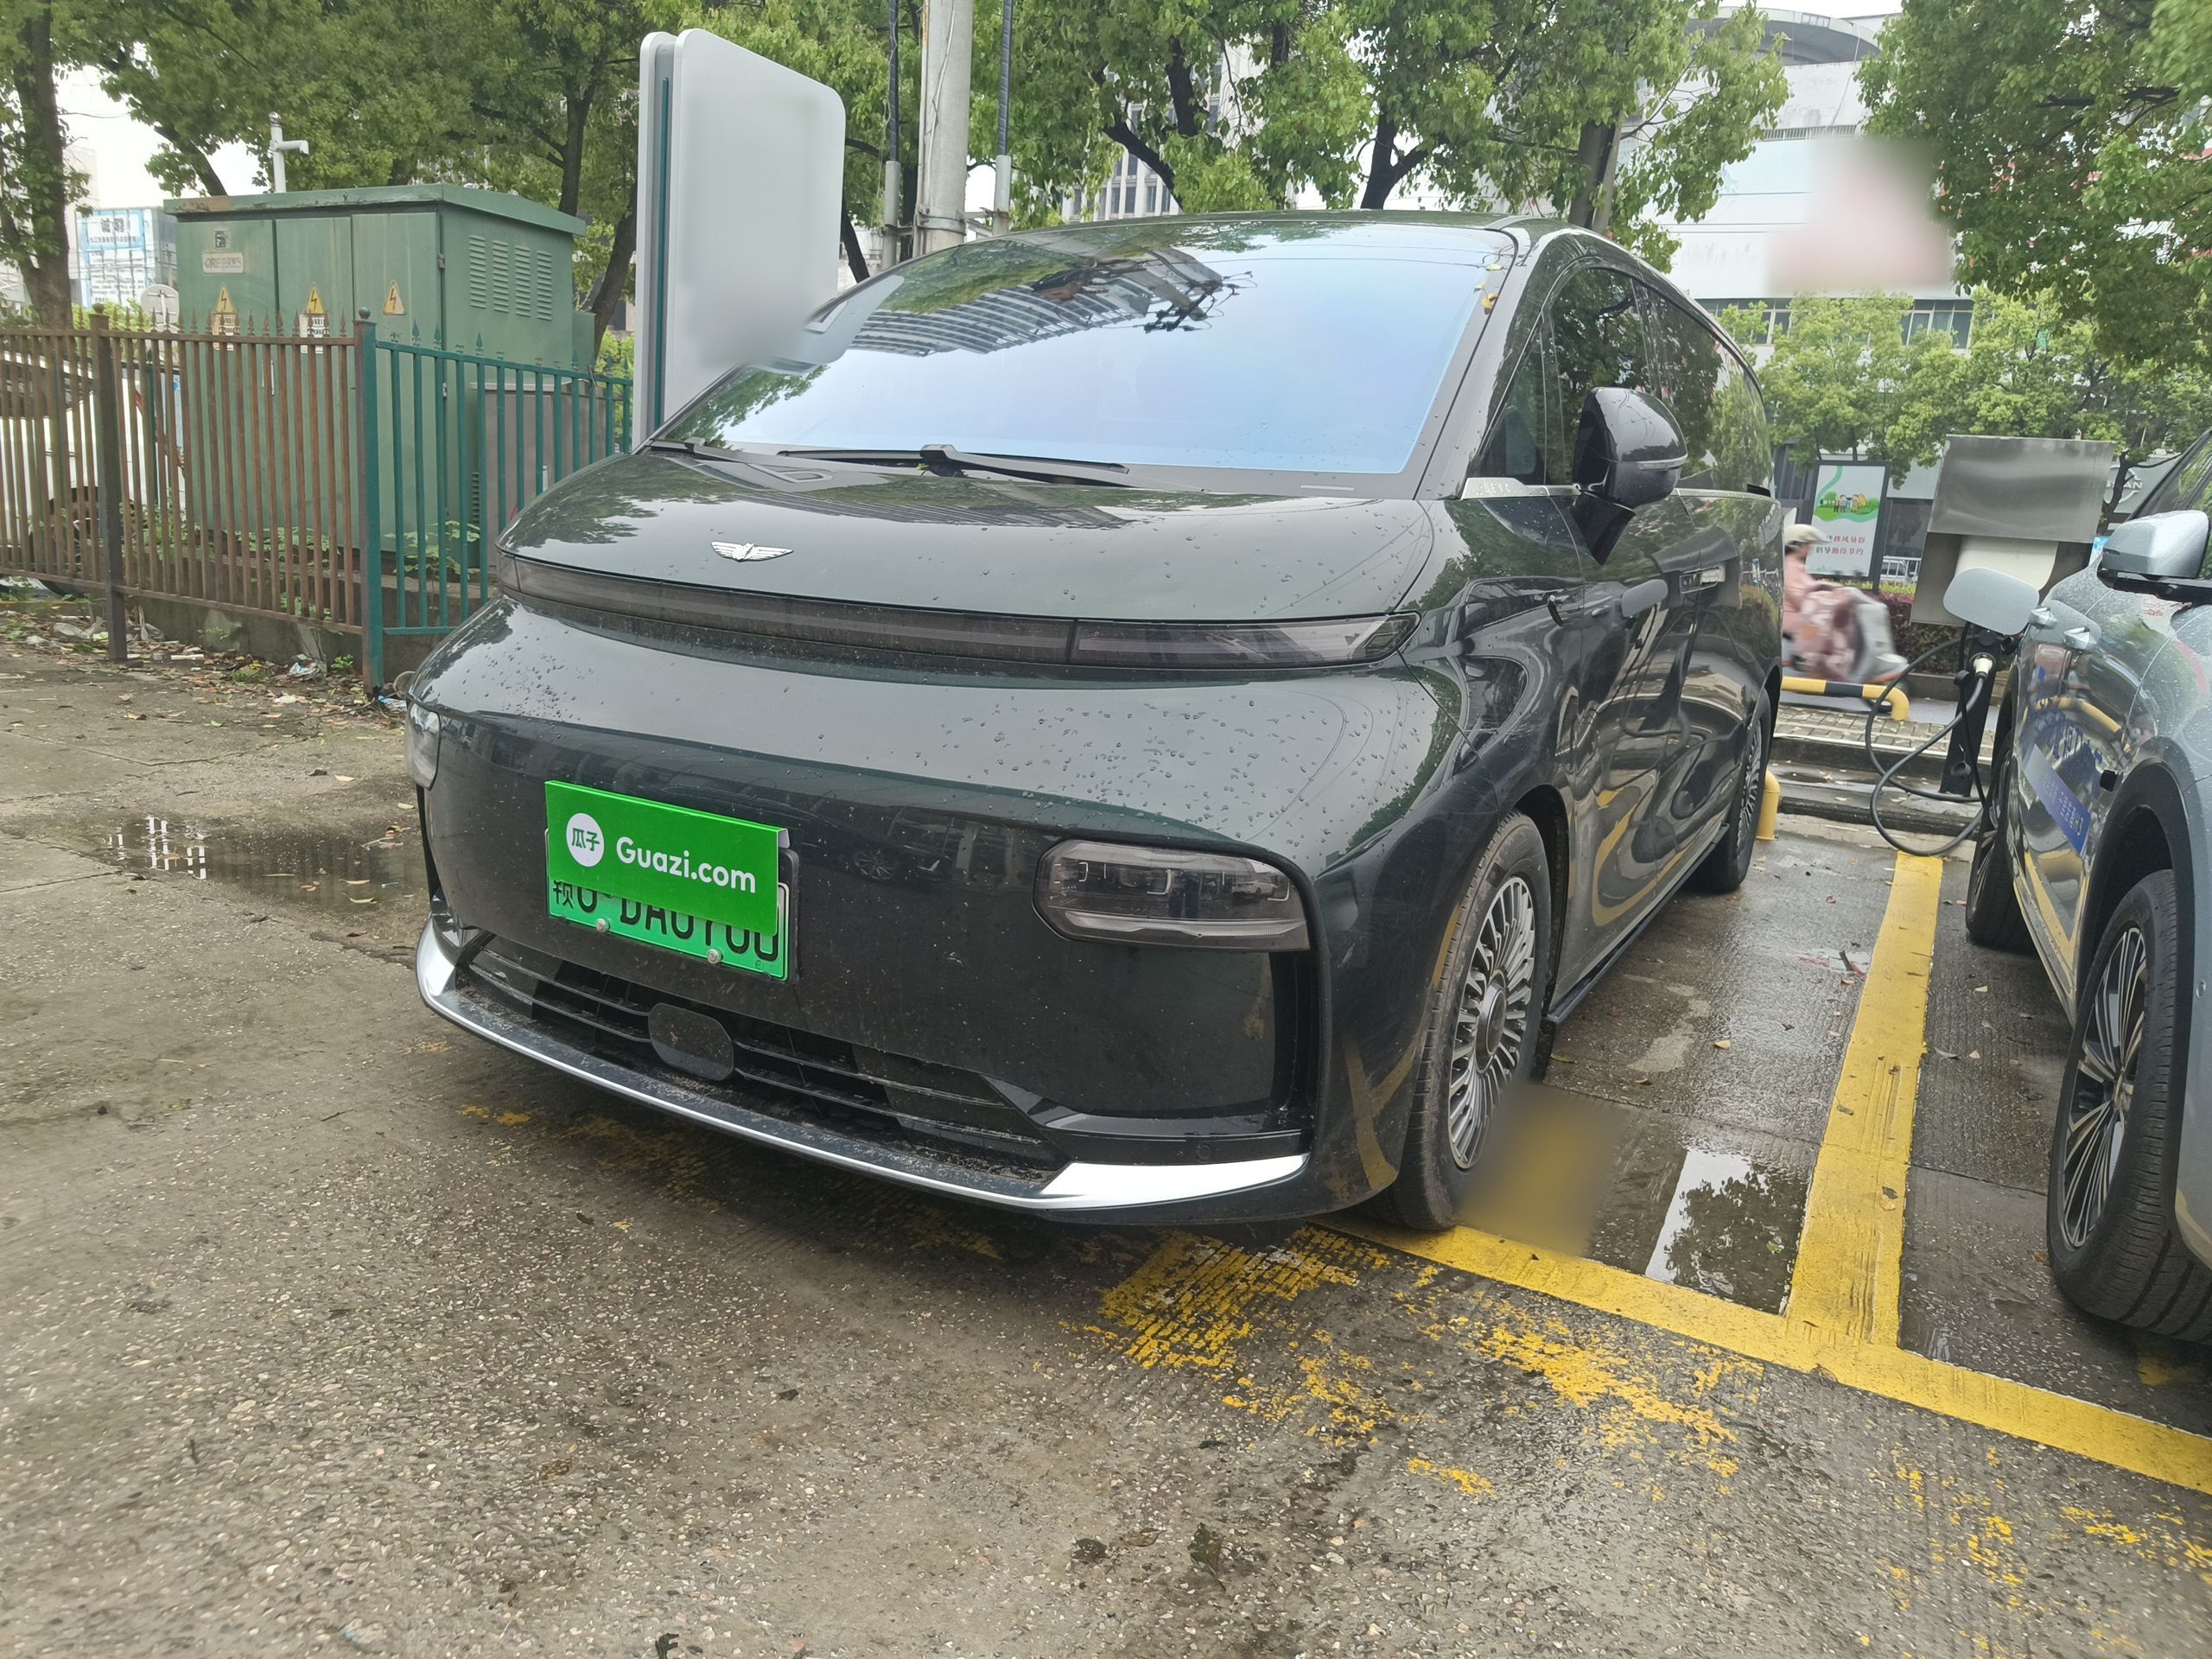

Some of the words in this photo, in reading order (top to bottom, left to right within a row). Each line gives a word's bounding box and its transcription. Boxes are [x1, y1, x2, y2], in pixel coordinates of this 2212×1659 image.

[1483, 483, 1510, 493] LEVC
[571, 827, 601, 852] 瓜子
[616, 836, 756, 893] Guazi.com
